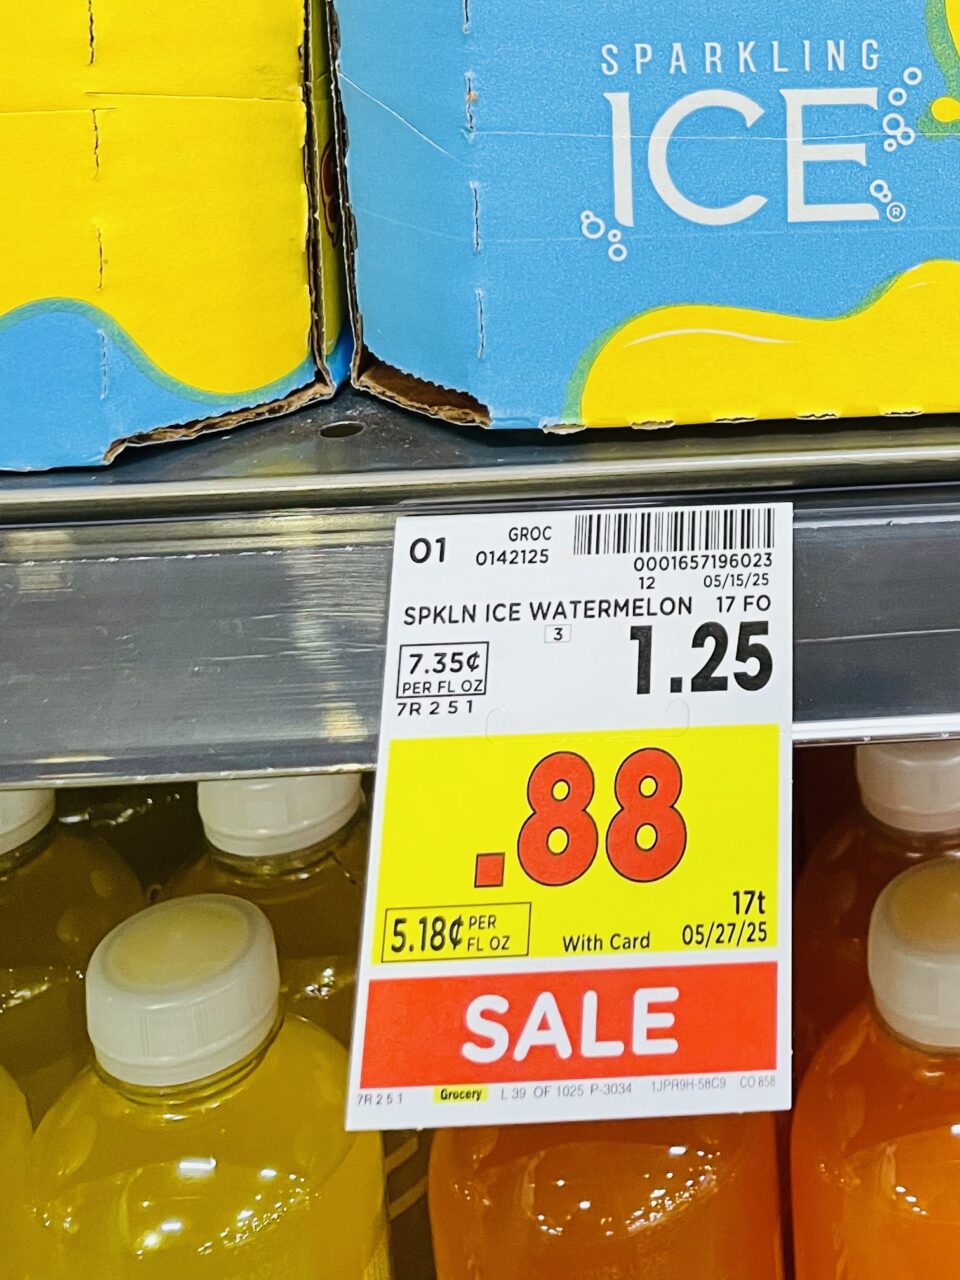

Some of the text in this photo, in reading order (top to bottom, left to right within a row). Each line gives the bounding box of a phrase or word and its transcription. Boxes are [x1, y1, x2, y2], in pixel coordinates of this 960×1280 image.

[602, 39, 881, 76] SPARKLING
[603, 86, 880, 228] ICE
[508, 526, 553, 542] GROC
[475, 549, 773, 572] 0142125 0001657196023
[638, 573, 770, 590] 12 05/15/25
[403, 595, 772, 626] SPKLN ICE WATERMELON 17 FO
[553, 627, 564, 642] 3
[408, 651, 481, 675] 7.35¢
[630, 621, 774, 695] 1.25
[402, 679, 484, 695] PER FL OZ
[474, 747, 688, 888] .88
[732, 889, 766, 915] 17t
[391, 915, 464, 954] 5.18¢
[469, 915, 497, 931] PER
[467, 935, 511, 952] FL OZ
[563, 921, 768, 952] With Card 05/27/25
[461, 986, 680, 1064] SALE
[501, 1083, 633, 1100] L 39 OF 1025 P-3034
[739, 1076, 756, 1088] CO
[440, 1087, 483, 1101] Grocery
